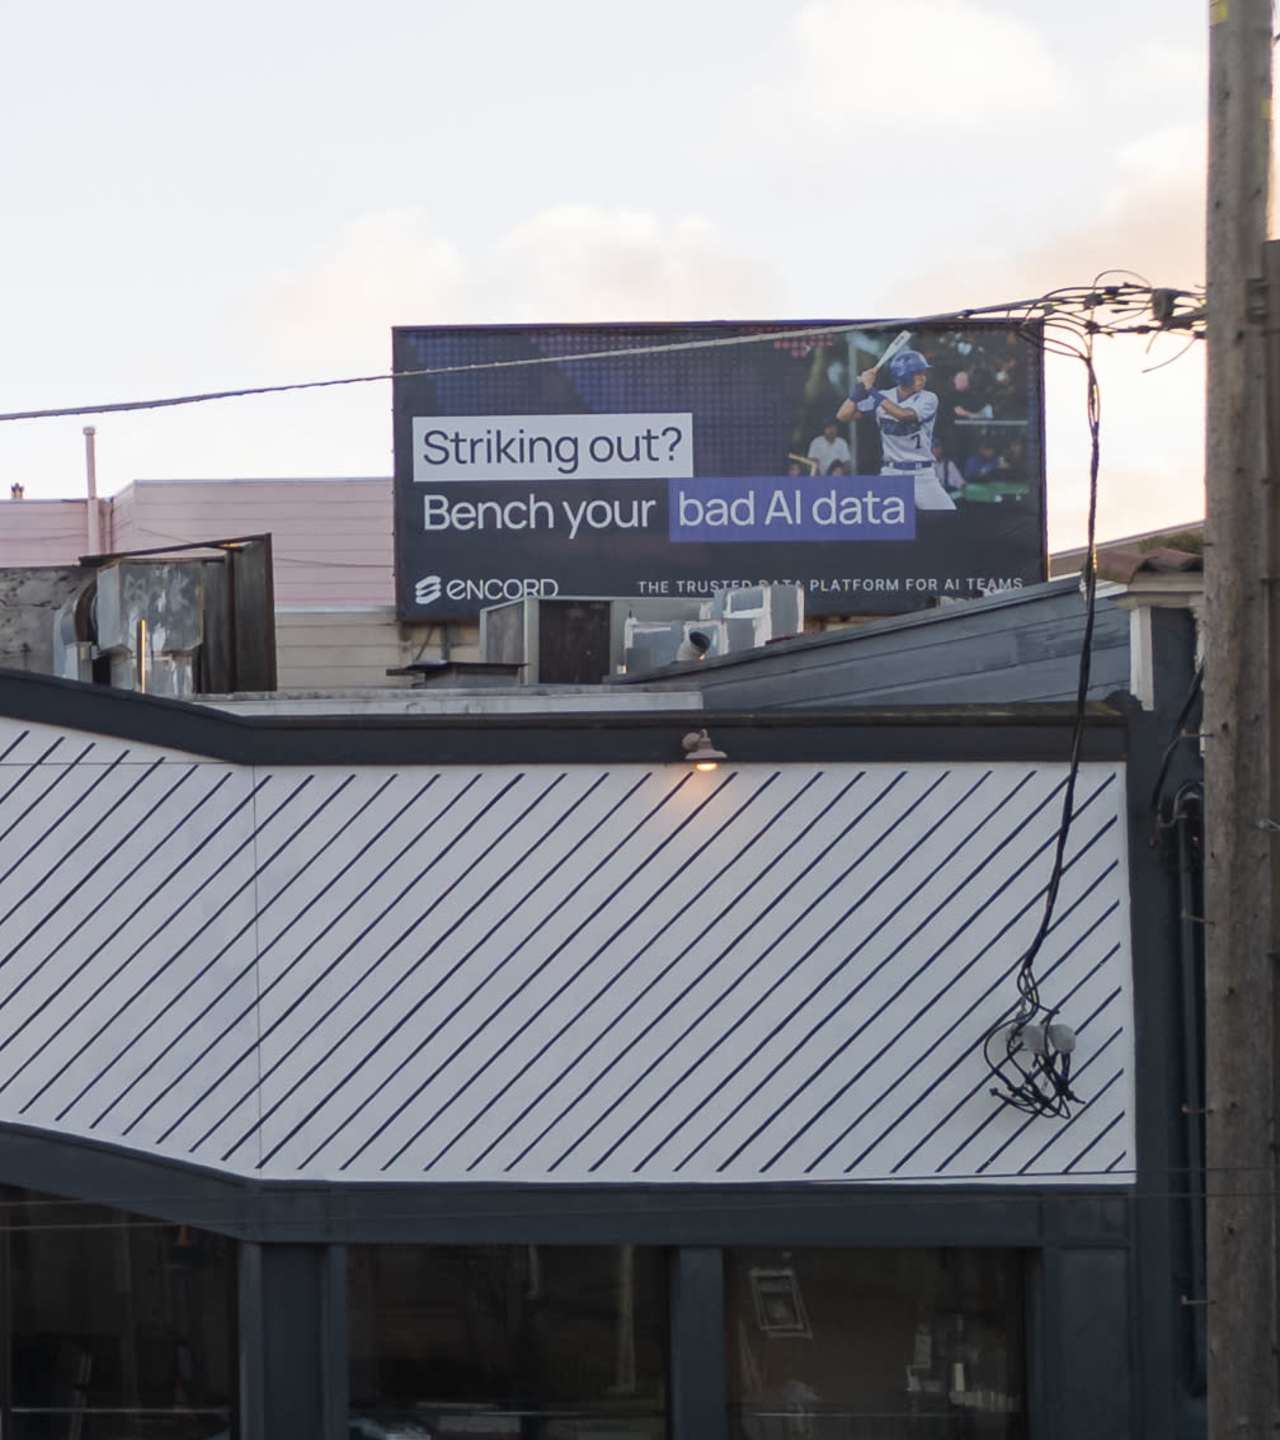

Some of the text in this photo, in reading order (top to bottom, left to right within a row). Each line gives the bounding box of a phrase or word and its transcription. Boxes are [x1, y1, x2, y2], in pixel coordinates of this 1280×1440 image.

[423, 426, 683, 475] Striking out?
[424, 489, 905, 540] Bench your bad AI data
[638, 580, 669, 594] THE
[809, 578, 900, 592] PLATFORM
[905, 578, 938, 591] FOR
[944, 578, 961, 591] AI
[966, 577, 1024, 591] TEAMS
